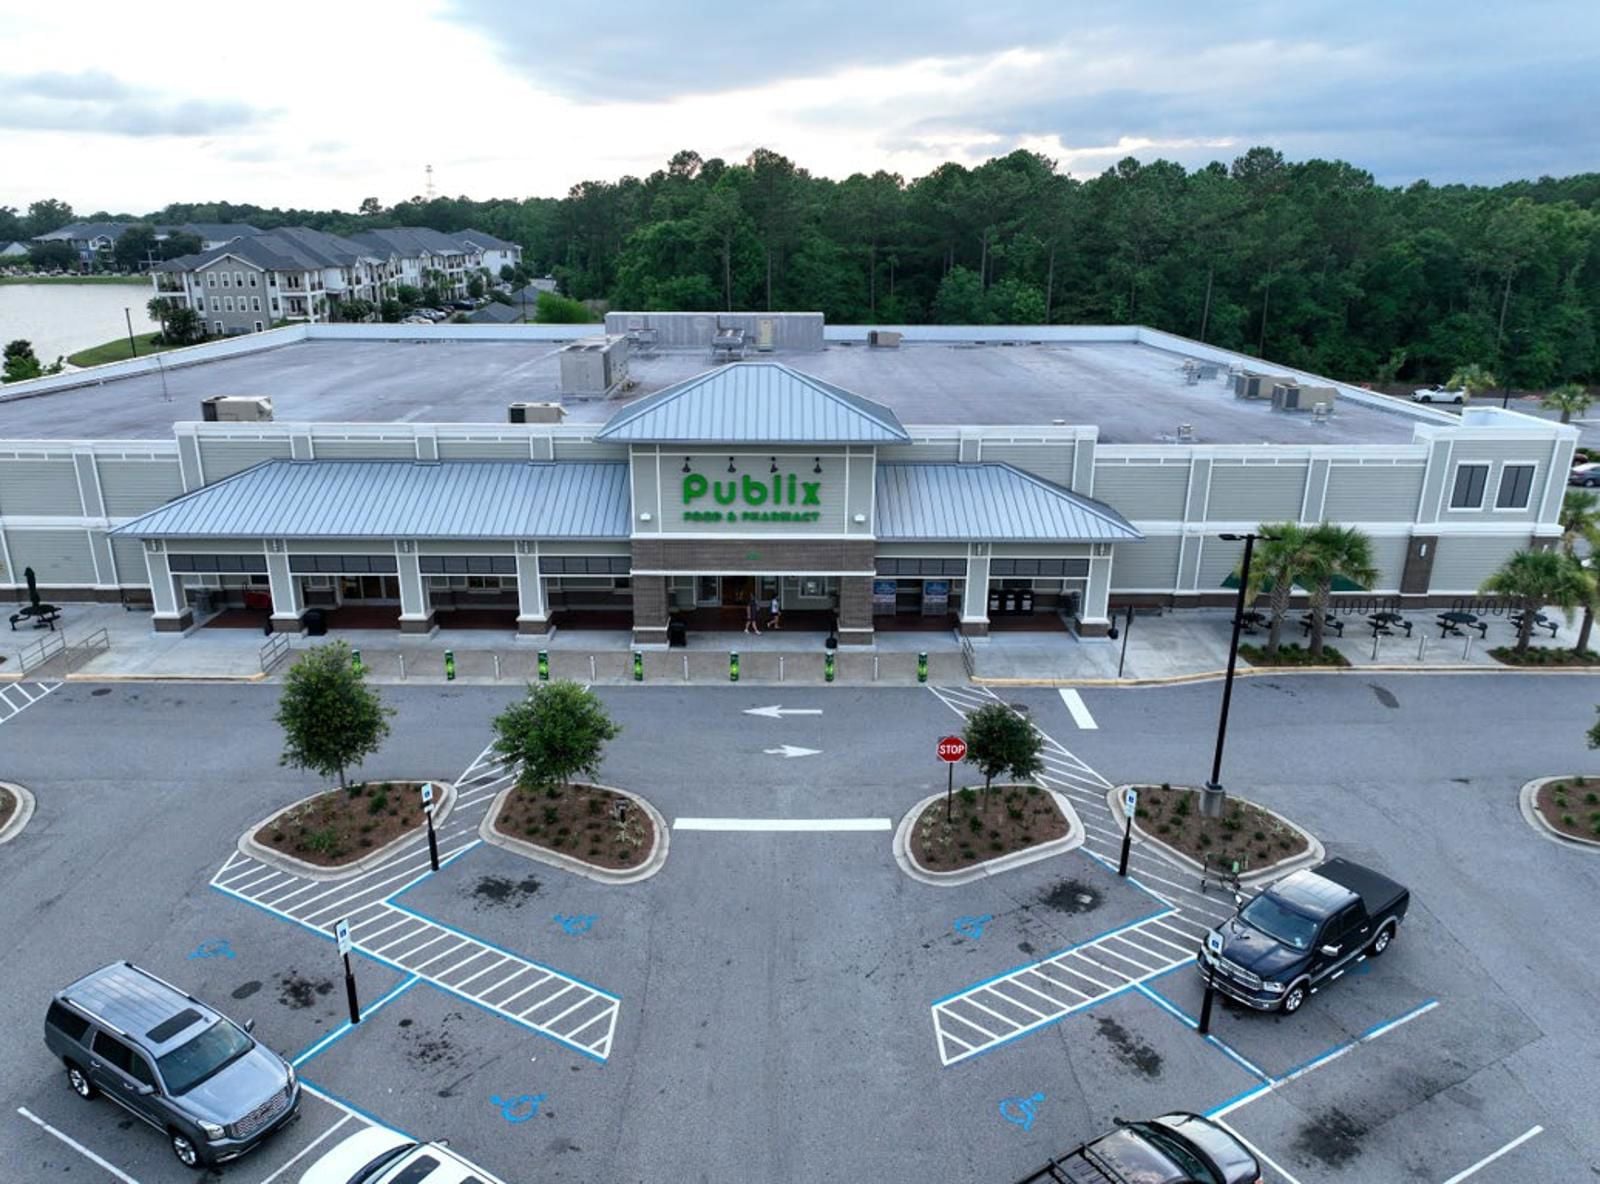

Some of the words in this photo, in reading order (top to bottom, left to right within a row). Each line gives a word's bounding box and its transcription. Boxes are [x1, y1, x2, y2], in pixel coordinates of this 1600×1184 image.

[683, 474, 821, 505] Publix
[683, 511, 722, 522] FOOD
[726, 511, 737, 522] &
[940, 744, 965, 755] STOP
